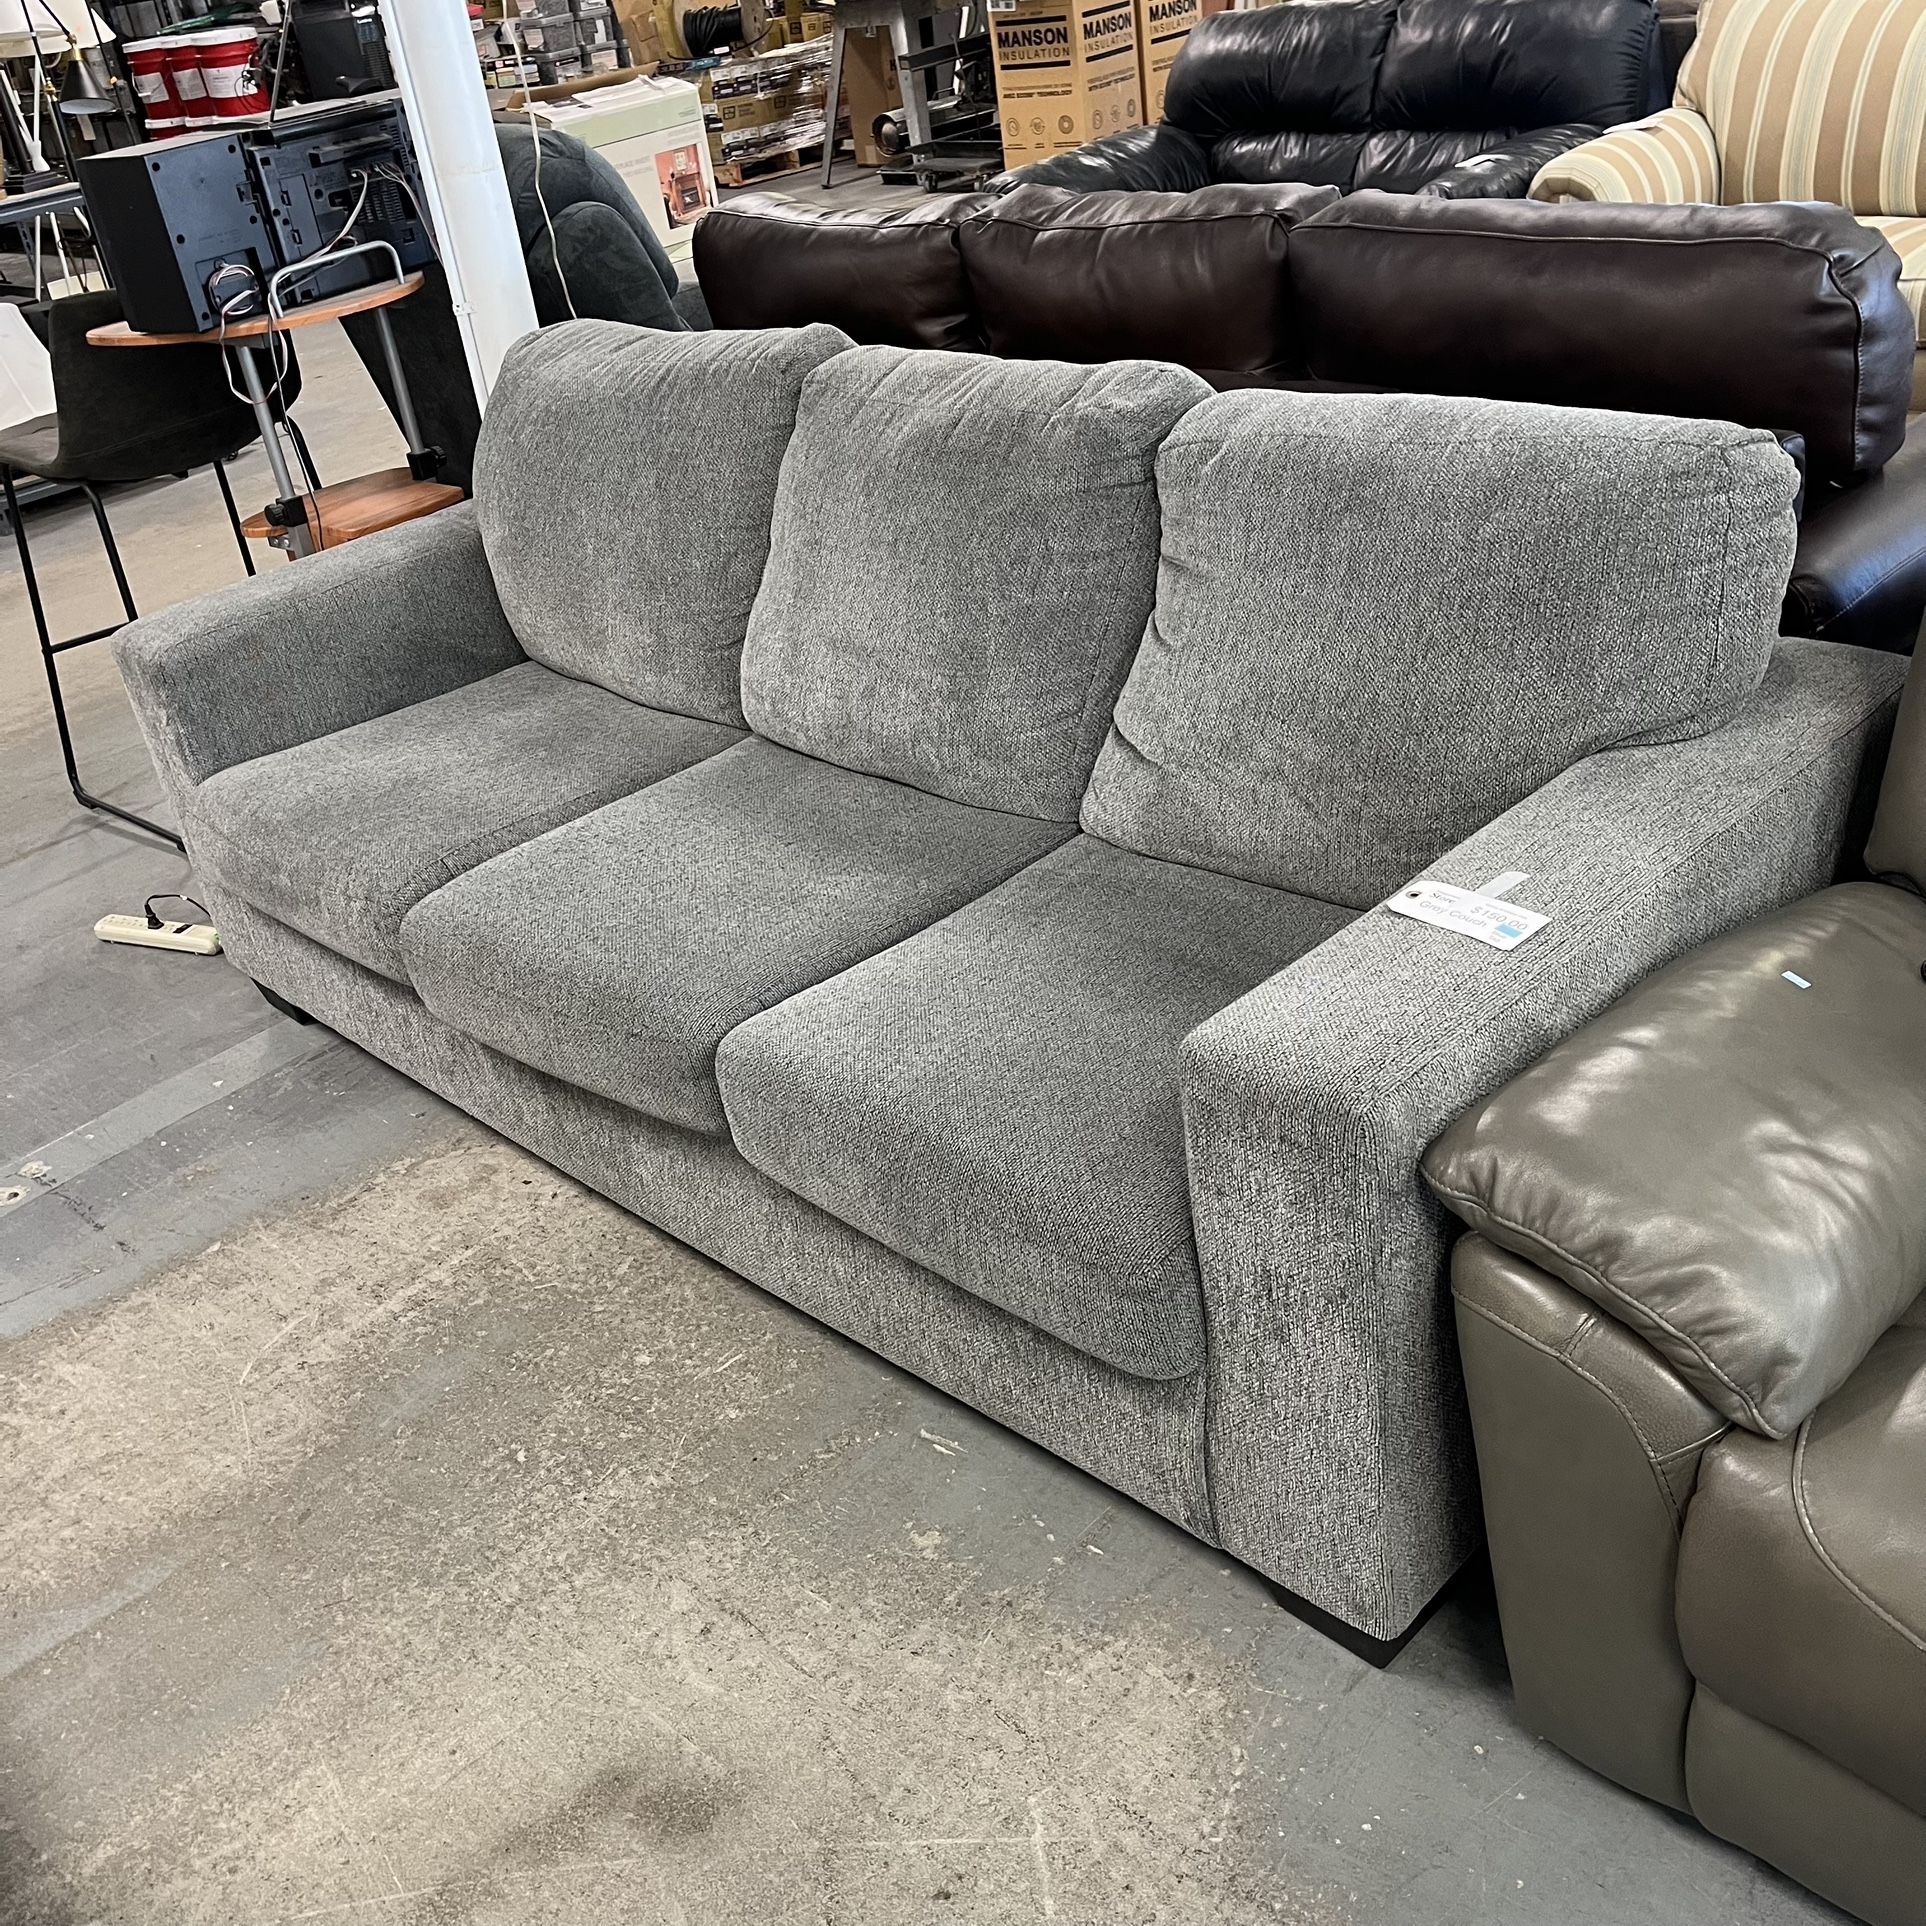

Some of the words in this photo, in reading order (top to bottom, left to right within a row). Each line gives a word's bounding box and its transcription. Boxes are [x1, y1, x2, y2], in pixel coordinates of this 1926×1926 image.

[1149, 0, 1198, 22] MANSON
[997, 26, 1069, 48] MANSON
[1083, 12, 1132, 40] MANSON
[1084, 31, 1134, 53] INSULATION
[998, 47, 1070, 61] INSULATION
[1449, 910, 1487, 928] Couch
